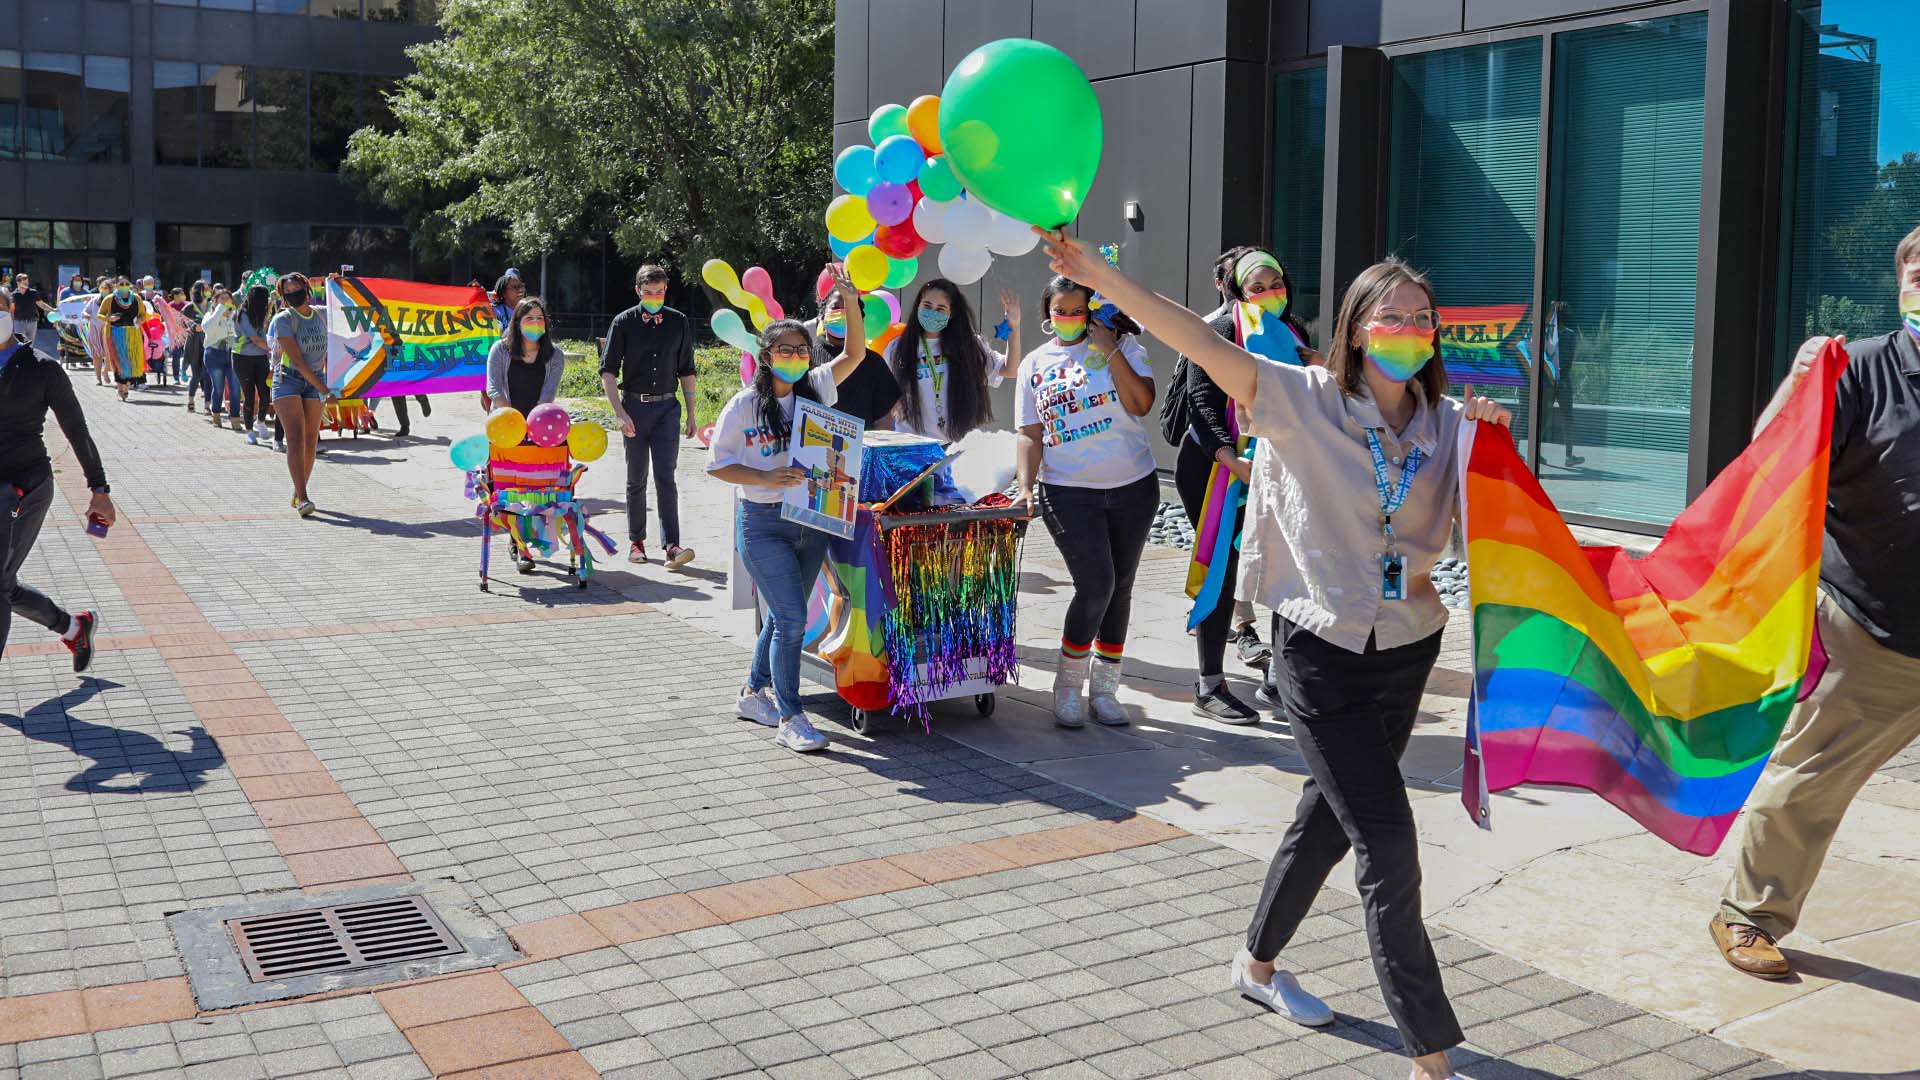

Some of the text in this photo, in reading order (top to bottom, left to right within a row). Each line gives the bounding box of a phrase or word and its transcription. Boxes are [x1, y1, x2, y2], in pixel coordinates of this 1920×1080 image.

[341, 305, 494, 336] WALKING
[384, 340, 491, 371] HAWK
[824, 420, 857, 440] PRIDE
